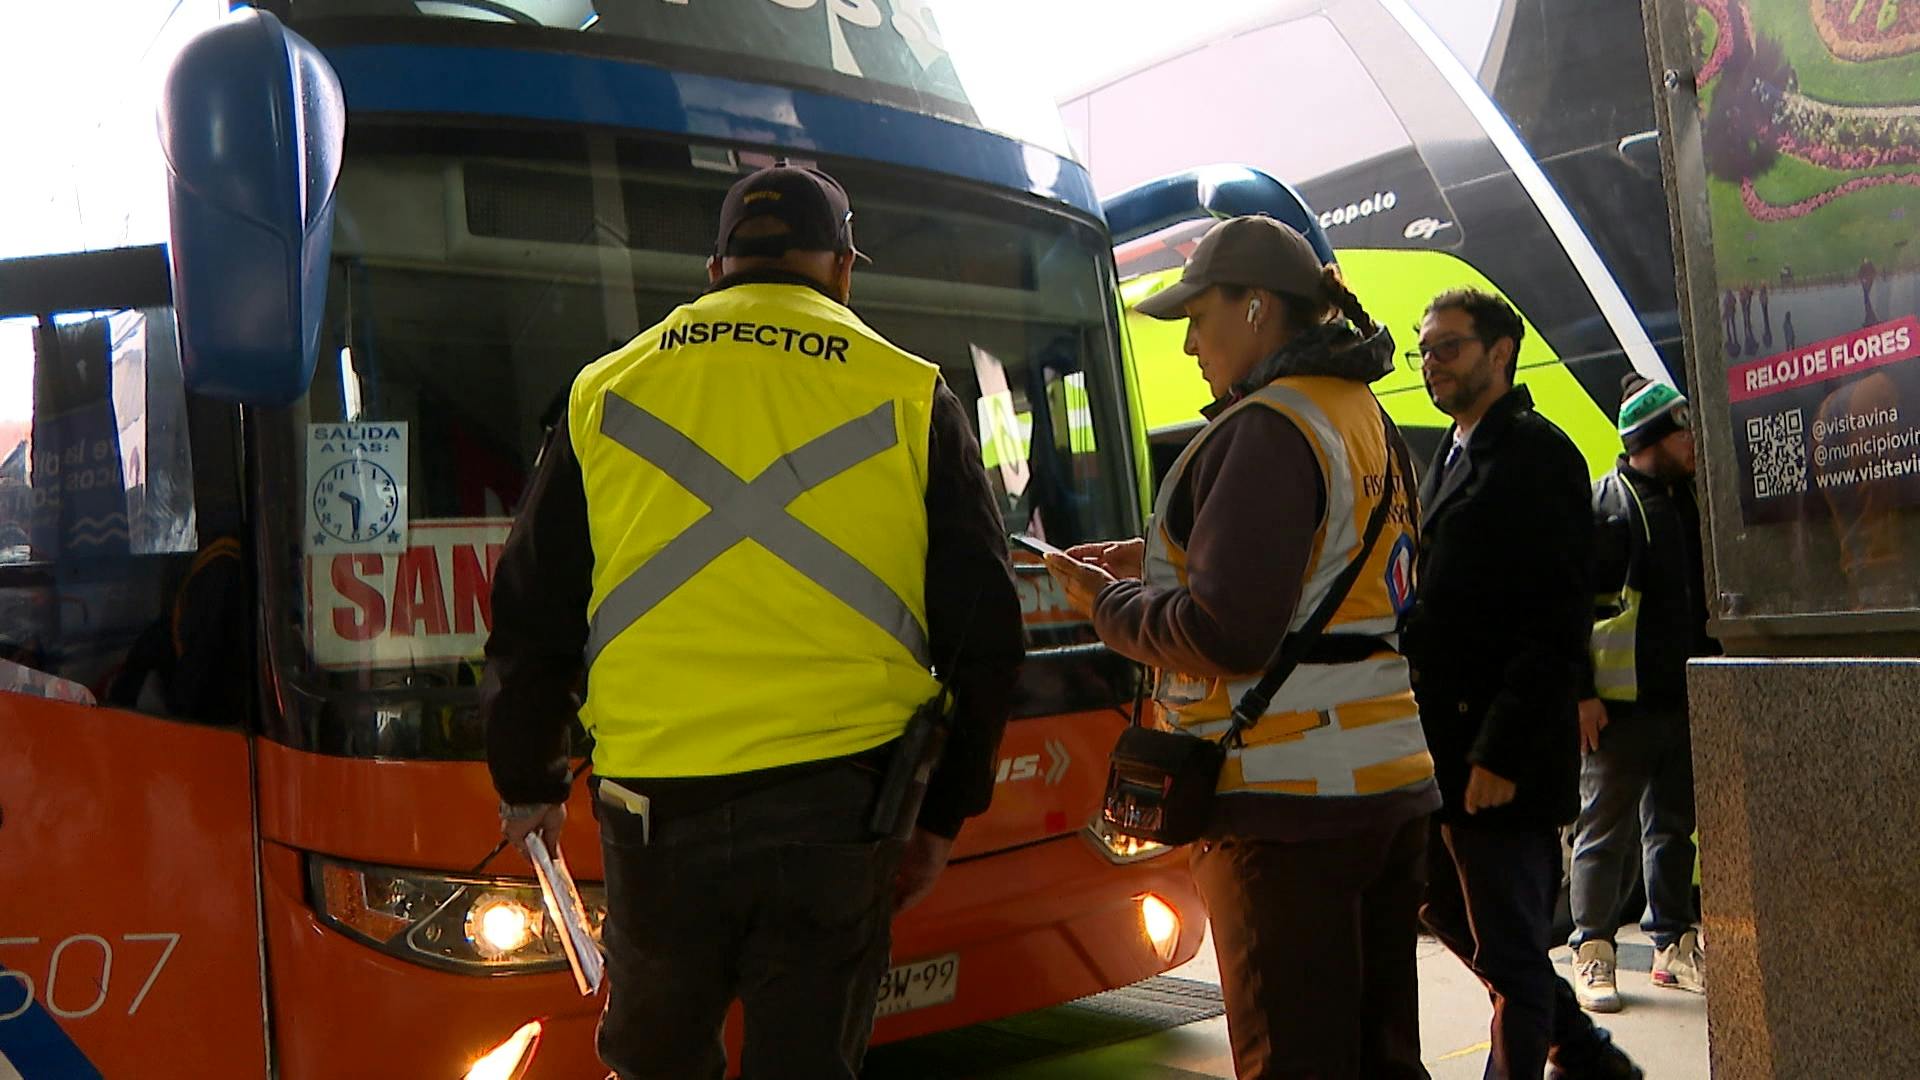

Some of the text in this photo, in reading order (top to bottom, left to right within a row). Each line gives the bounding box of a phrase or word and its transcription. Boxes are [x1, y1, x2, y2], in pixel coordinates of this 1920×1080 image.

[1317, 191, 1396, 229] copolo
[659, 322, 849, 363] INSPECTOR
[1745, 327, 1911, 392] RELOJ DE FLORES
[1812, 408, 1898, 441] @visitavina
[315, 427, 400, 440] SALIDA
[321, 443, 389, 453] A LAS:
[334, 468, 344, 480] 11
[372, 468, 377, 480] 1
[383, 480, 391, 492] 2
[369, 523, 378, 536] 5
